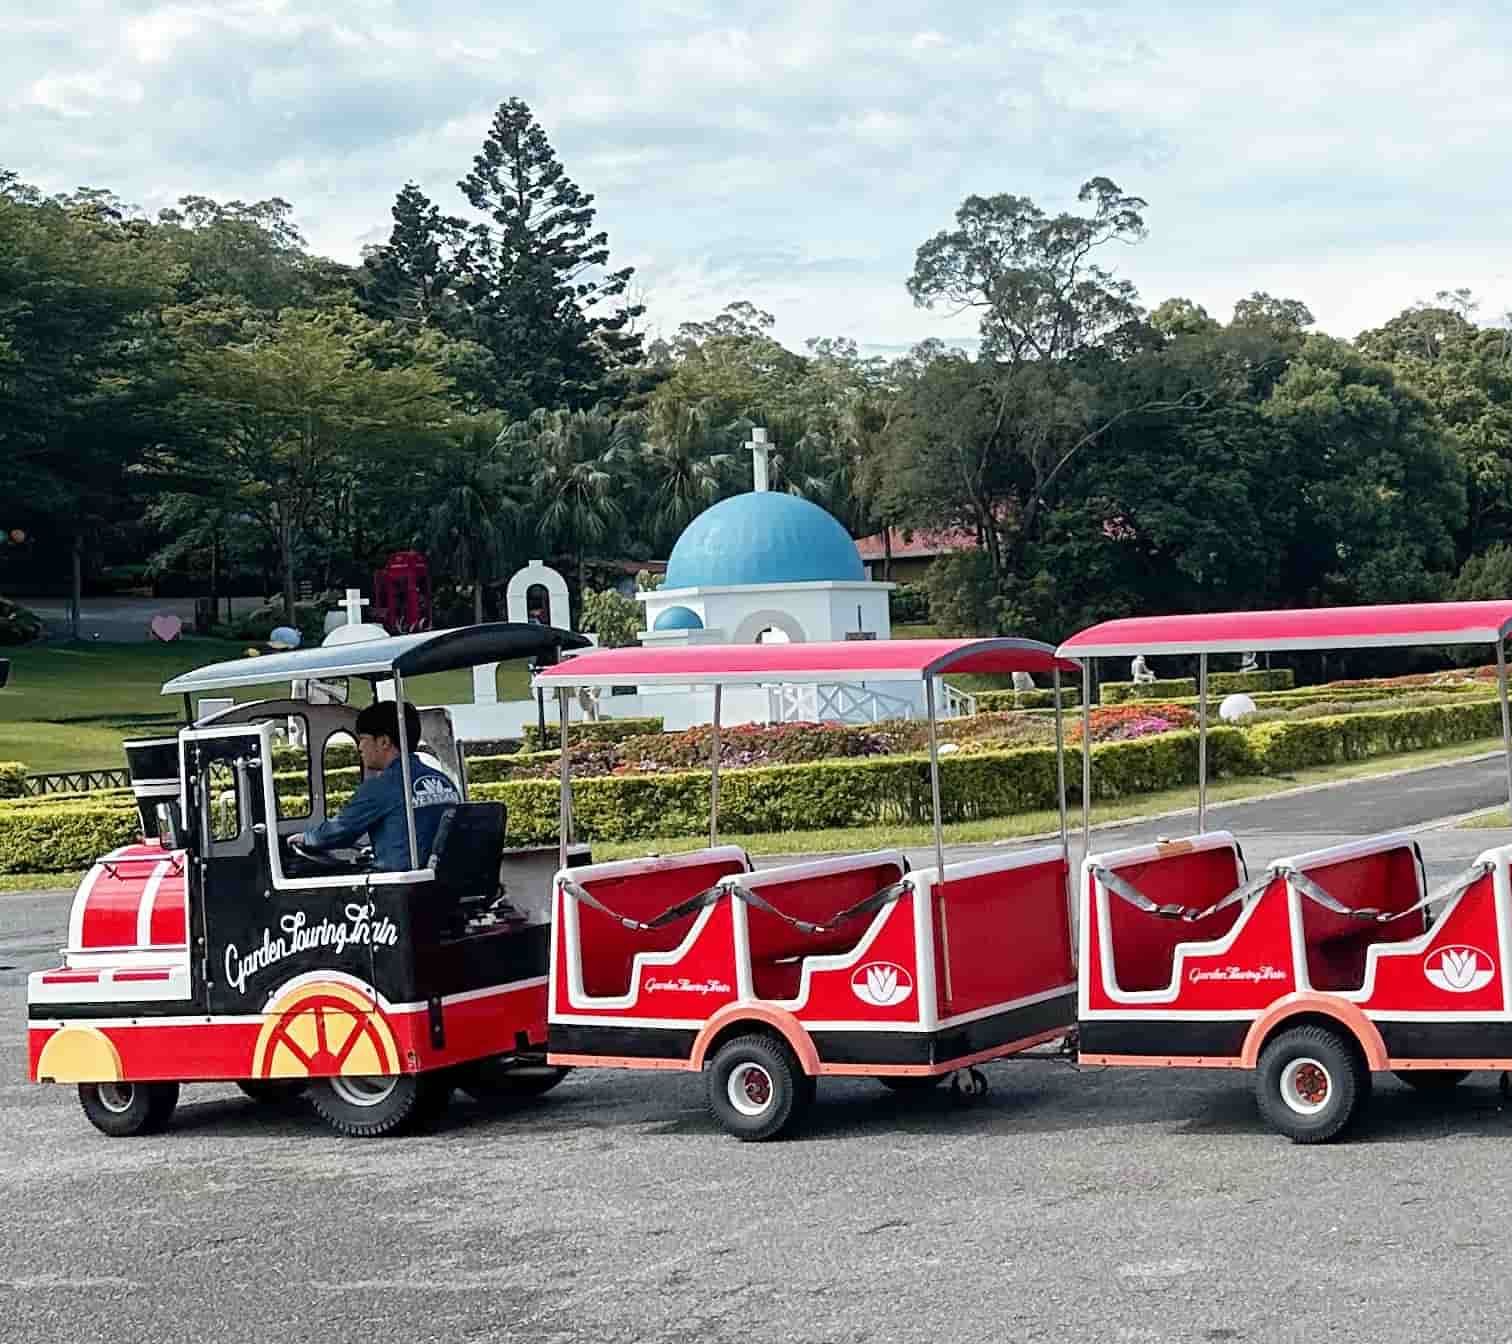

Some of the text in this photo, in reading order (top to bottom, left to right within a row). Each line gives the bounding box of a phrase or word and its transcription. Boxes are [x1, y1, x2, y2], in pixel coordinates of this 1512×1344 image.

[225, 903, 398, 994] Garden Touring Train
